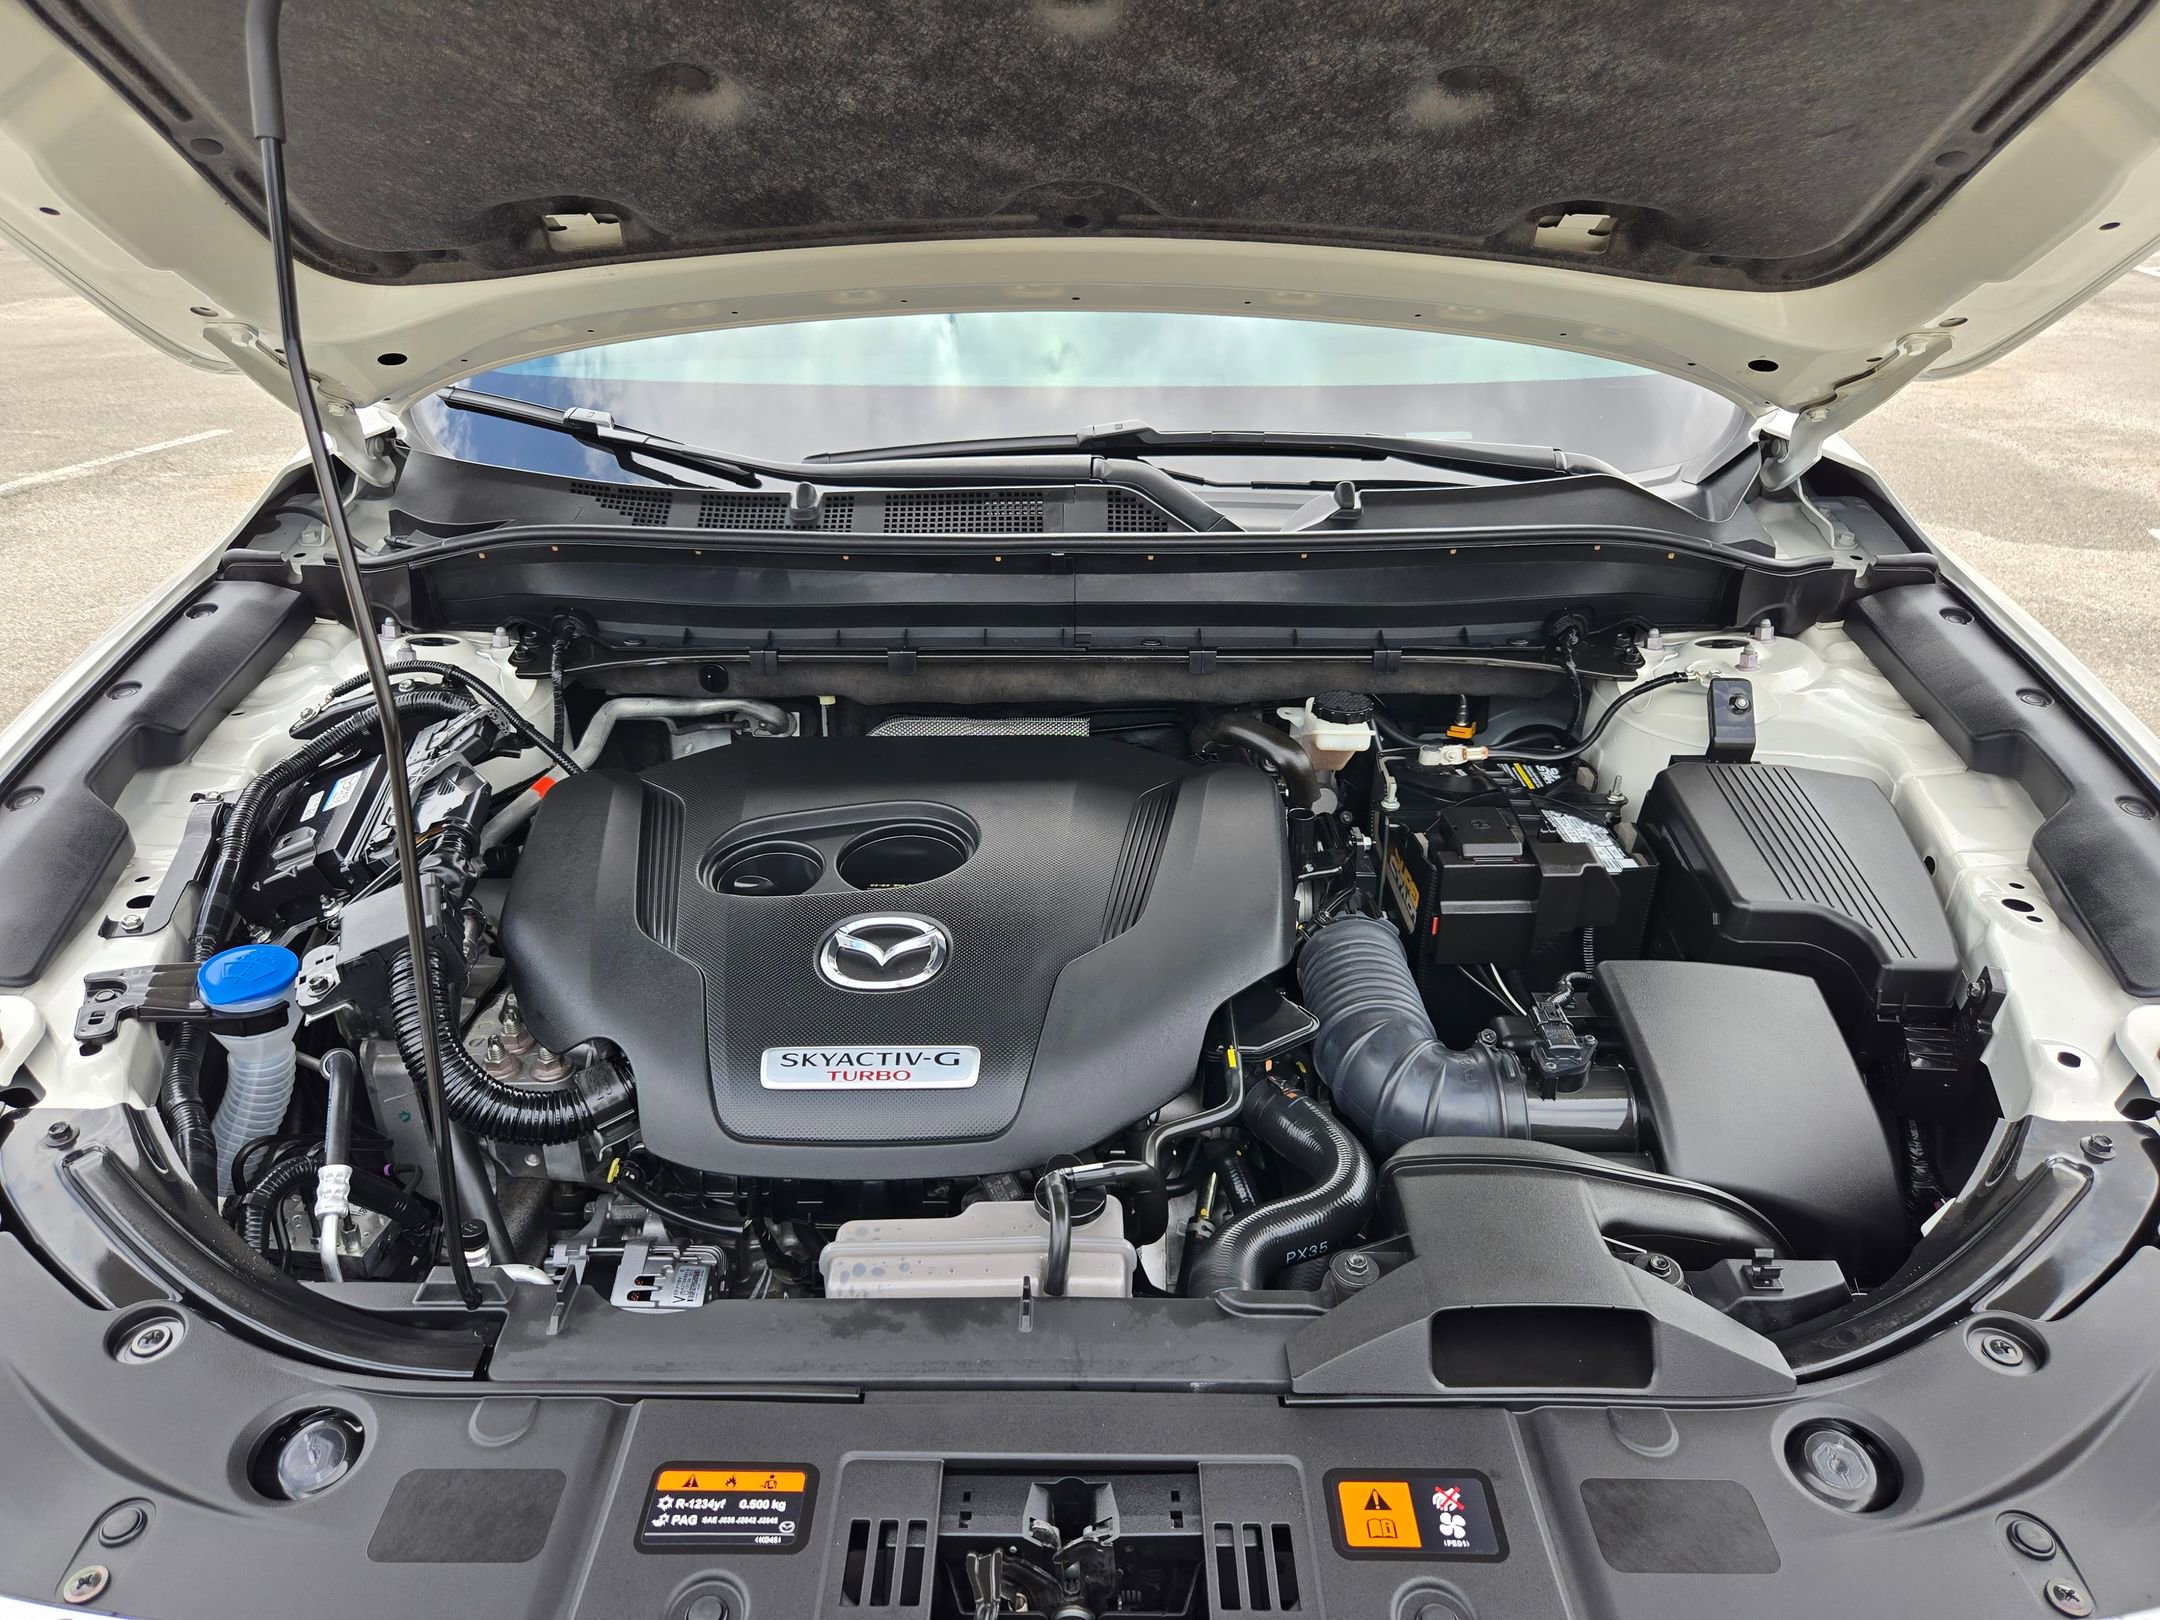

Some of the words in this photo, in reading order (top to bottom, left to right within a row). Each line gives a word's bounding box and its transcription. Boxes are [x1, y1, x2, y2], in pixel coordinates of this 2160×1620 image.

[780, 1051, 961, 1067] SKYACTIV-G
[826, 1070, 912, 1082] TURBO
[1285, 1240, 1328, 1264] PX35
[675, 1498, 726, 1511] R-1234yf
[771, 1499, 786, 1512] kg
[671, 1514, 698, 1526] PAG
